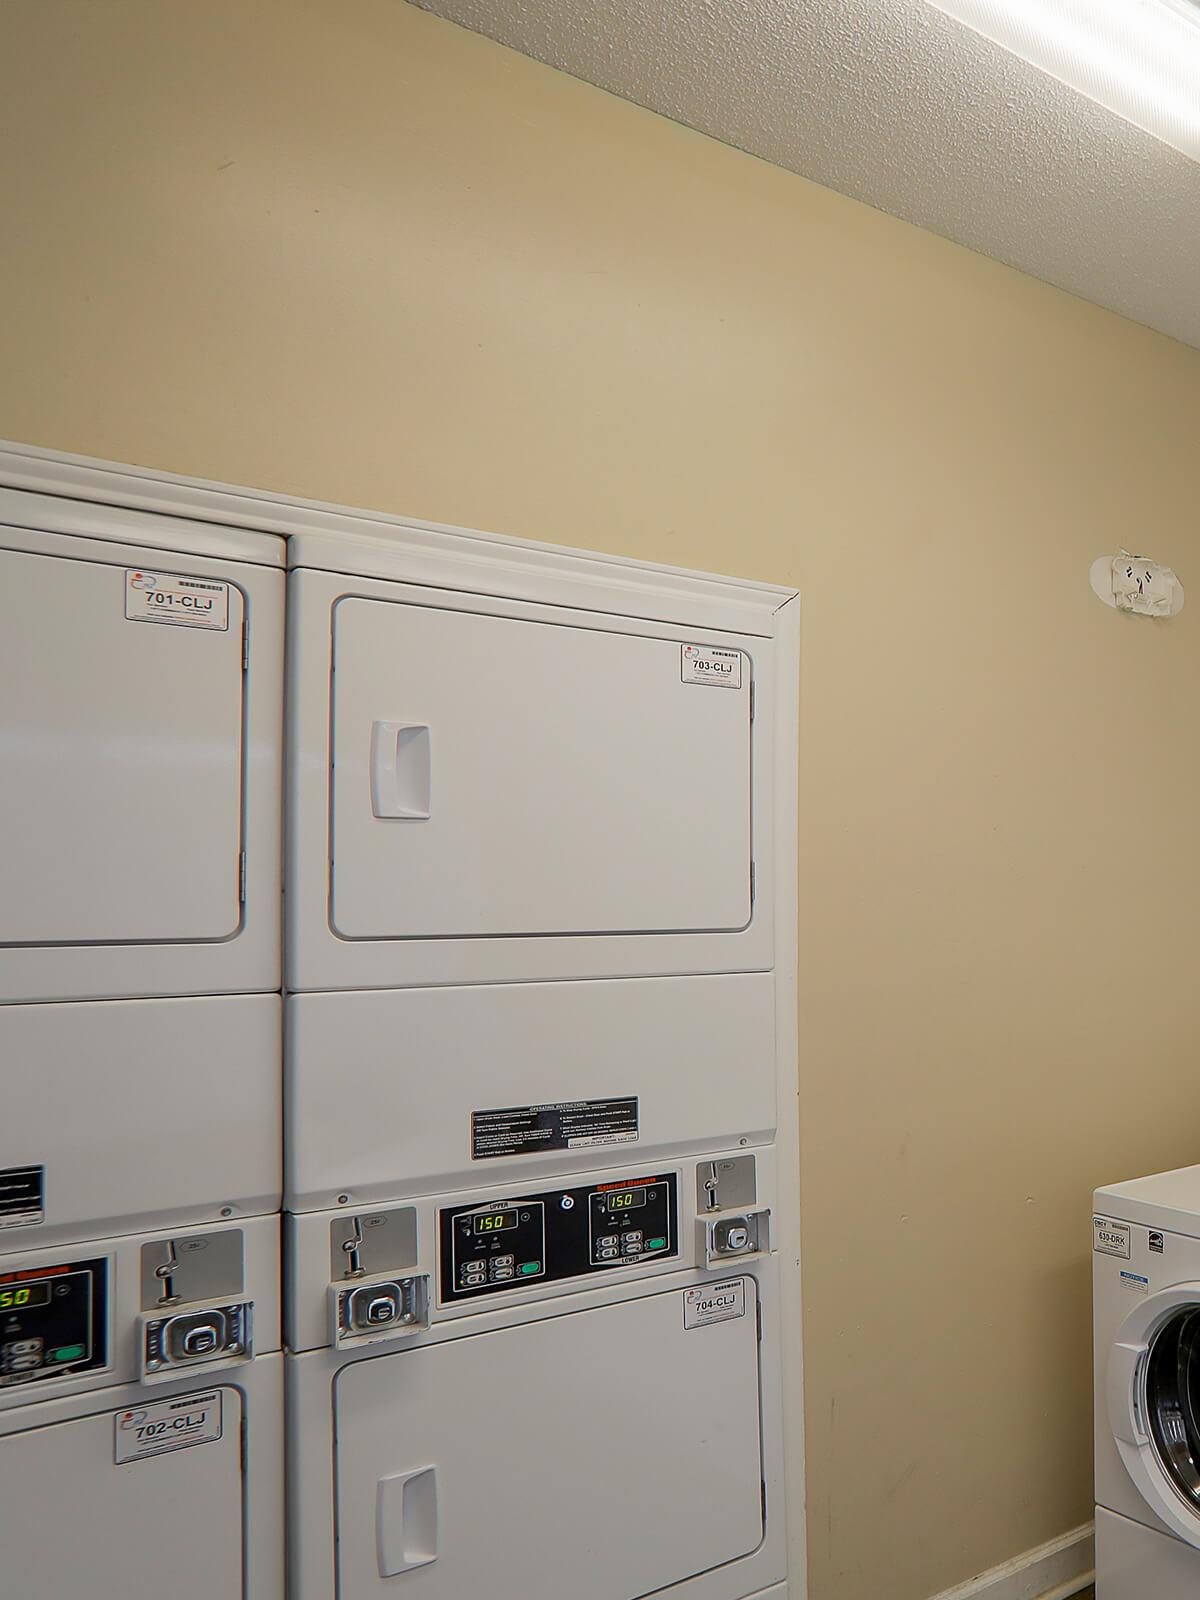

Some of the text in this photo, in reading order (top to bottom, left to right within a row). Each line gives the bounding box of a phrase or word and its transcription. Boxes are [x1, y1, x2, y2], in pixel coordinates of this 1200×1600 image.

[145, 591, 213, 610] 701-CLJ
[693, 660, 732, 673] 703-CLJ
[596, 1177, 657, 1192] Speed Queen
[489, 1202, 509, 1210] UPPER
[611, 1194, 632, 1208] 150
[479, 1216, 503, 1230] 150
[621, 1256, 640, 1264] LOWER
[695, 1294, 736, 1311] 704-CLJ
[136, 1412, 206, 1439] 702-CLJ
